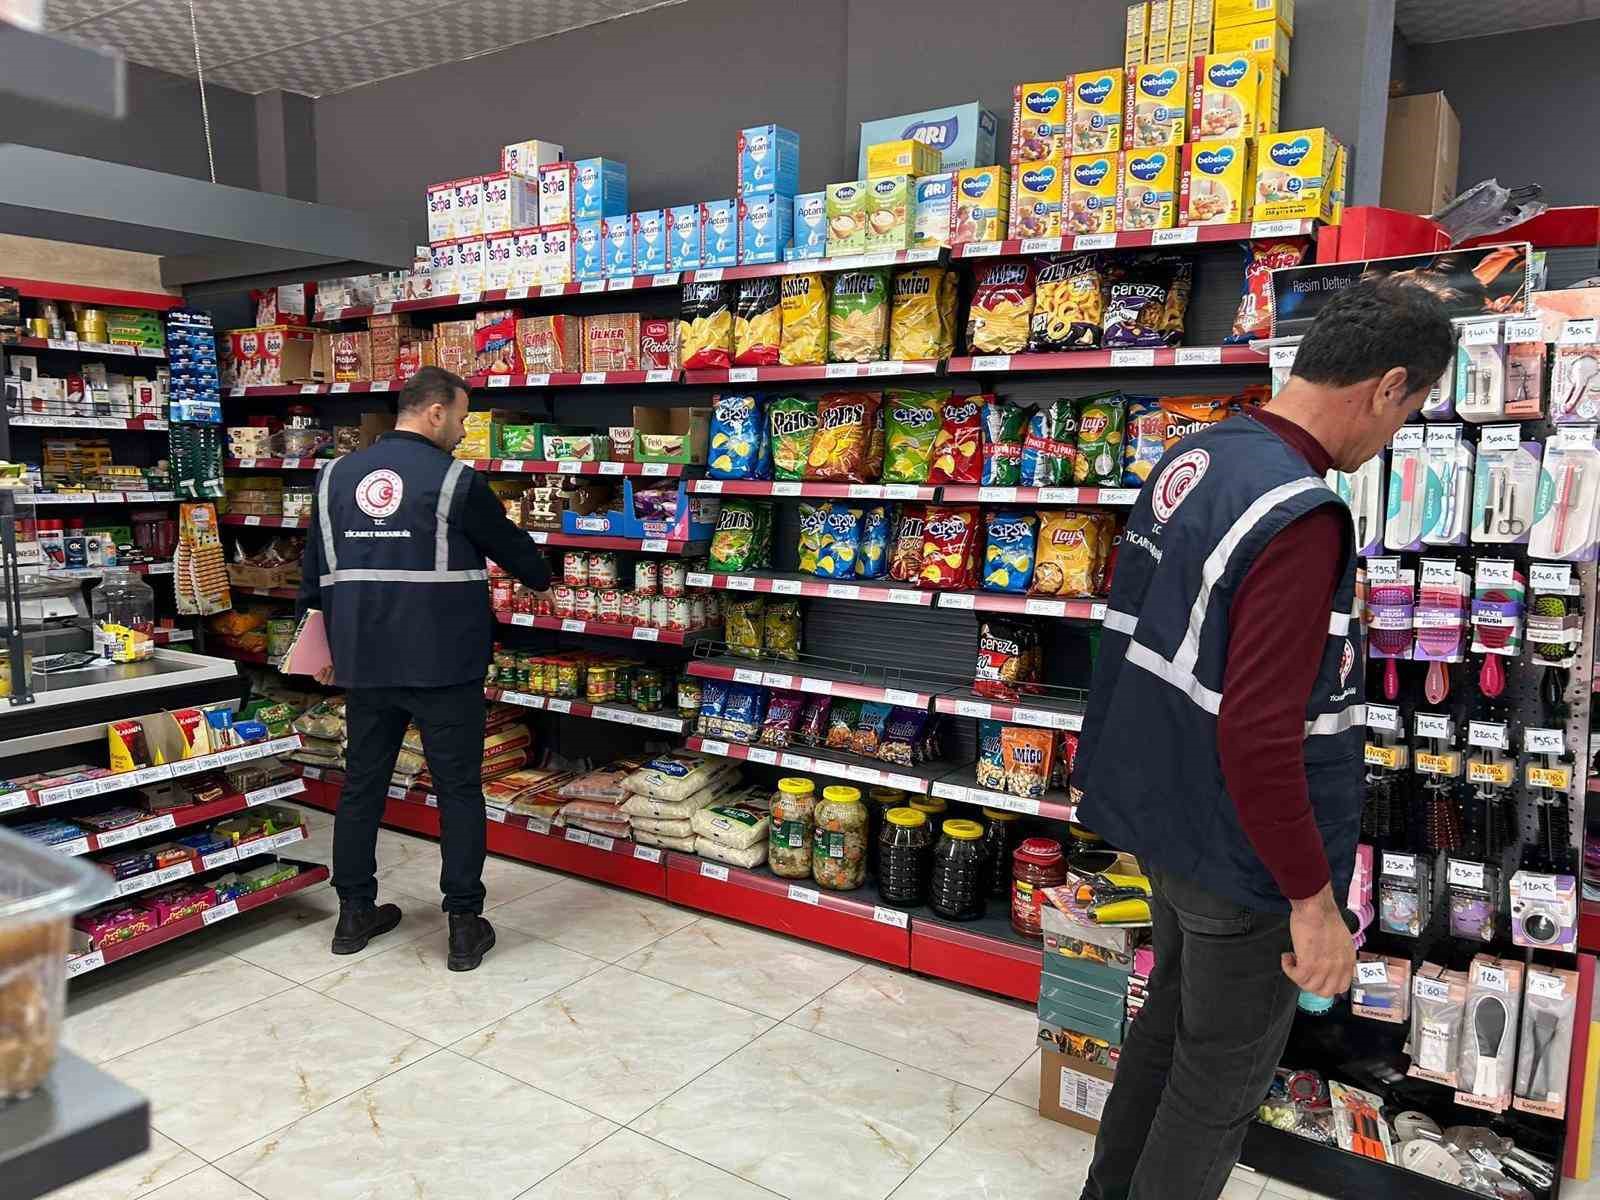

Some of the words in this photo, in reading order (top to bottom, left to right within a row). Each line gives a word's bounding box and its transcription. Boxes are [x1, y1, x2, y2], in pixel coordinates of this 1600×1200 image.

[1210, 66, 1245, 79] bebelac
[1142, 74, 1175, 88] bebelac
[1272, 145, 1309, 159] bebelac
[1293, 277, 1320, 293] Resim
[590, 326, 625, 341] ÜLKER
